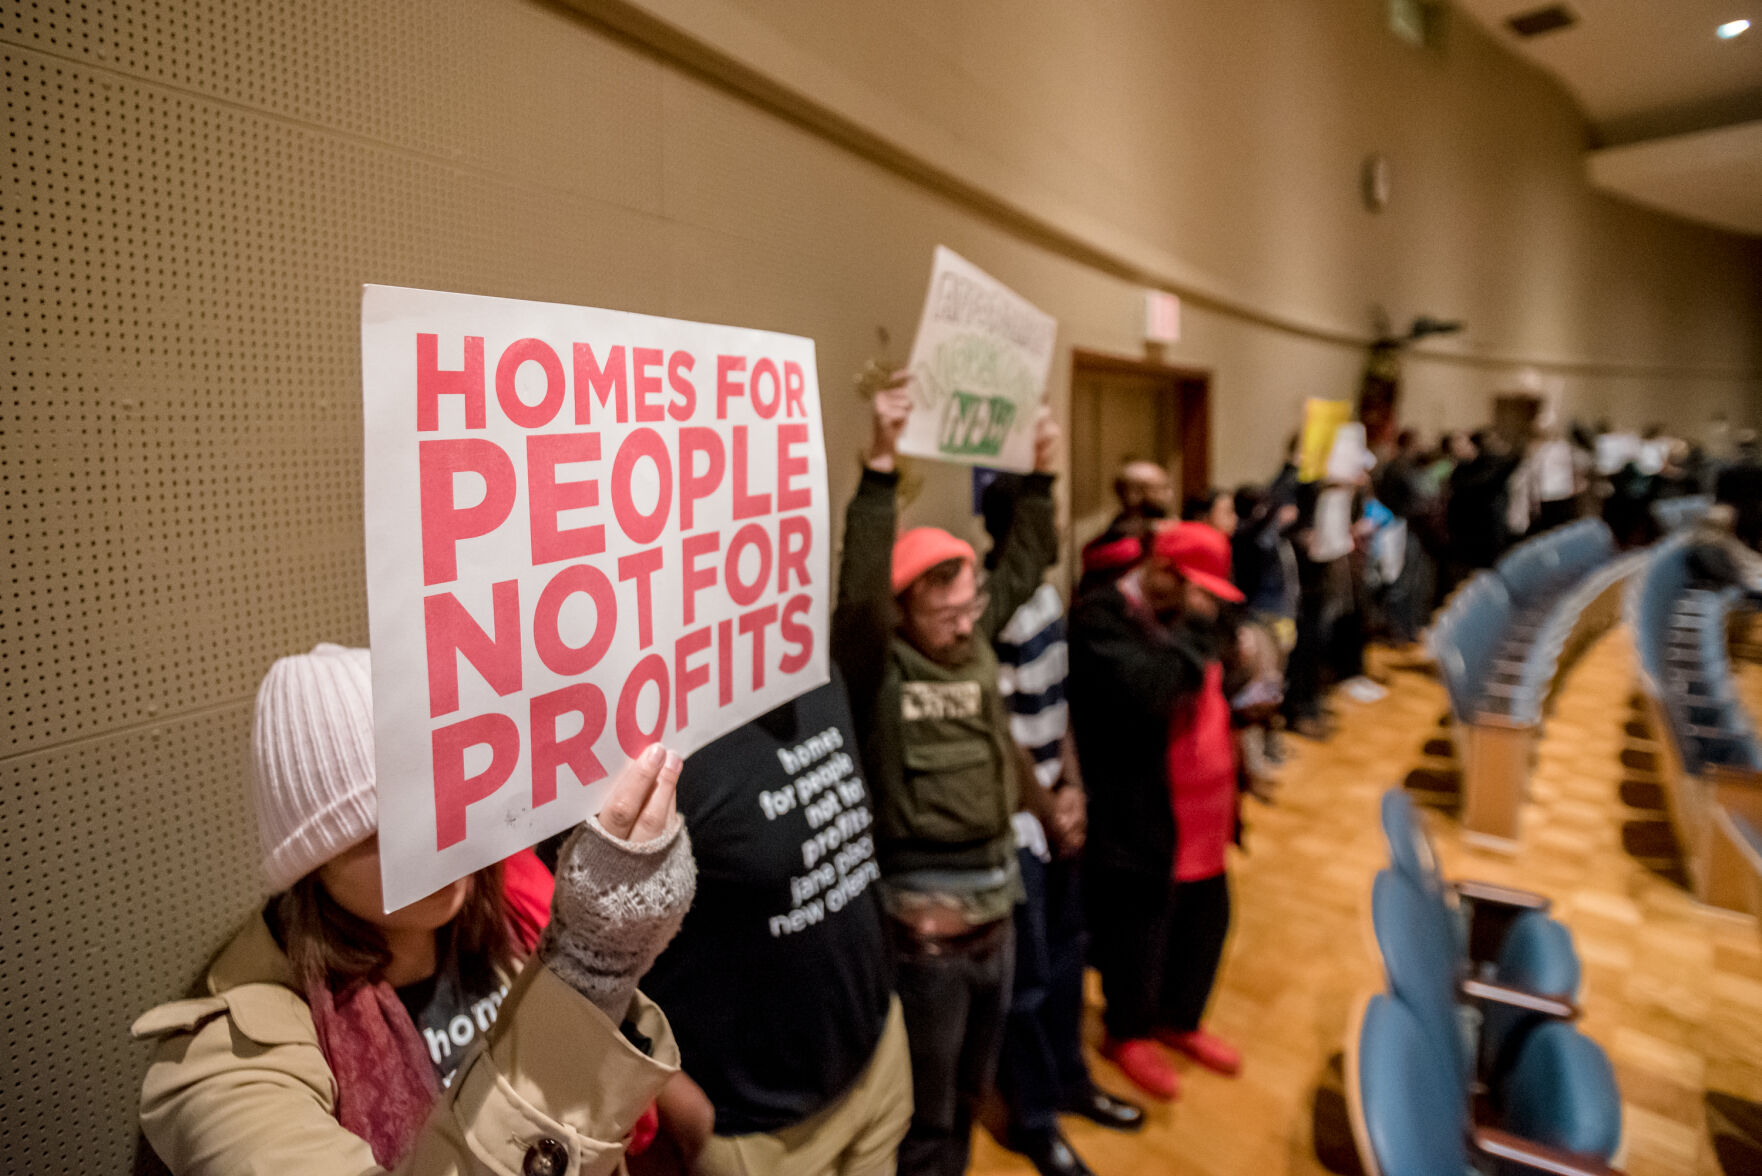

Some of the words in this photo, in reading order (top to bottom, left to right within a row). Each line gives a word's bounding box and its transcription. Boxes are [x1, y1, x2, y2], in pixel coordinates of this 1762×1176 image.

[416, 332, 697, 432] HOMES
[716, 354, 807, 421] FOR
[418, 423, 813, 587] PEOPLE
[423, 545, 664, 719] NOT
[681, 514, 813, 627] FOR
[431, 593, 814, 852] PROFITS
[777, 727, 843, 775] homes
[759, 785, 796, 820] for
[794, 752, 853, 805] people
[804, 790, 842, 829] not
[769, 898, 824, 937] new
[423, 985, 508, 1065] hom
